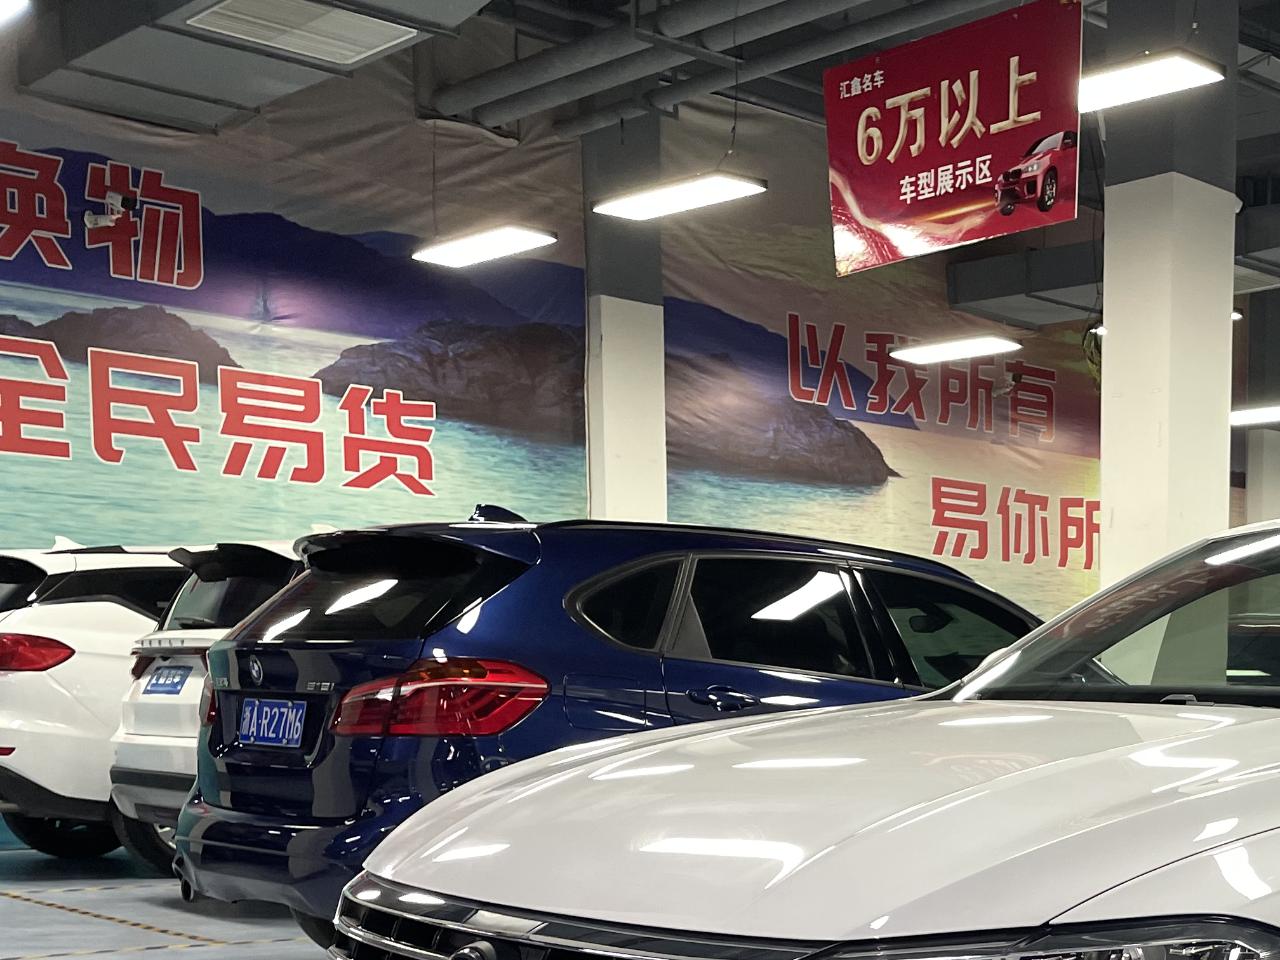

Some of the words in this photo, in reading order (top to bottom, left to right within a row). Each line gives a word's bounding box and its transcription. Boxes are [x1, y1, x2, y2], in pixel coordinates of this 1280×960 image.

[839, 70, 885, 99] 汇鑫名车
[857, 55, 1041, 166] 6万以上
[899, 154, 993, 204] 车型展示区
[0, 334, 437, 496] 全民易货
[787, 312, 1056, 441] 以我所有
